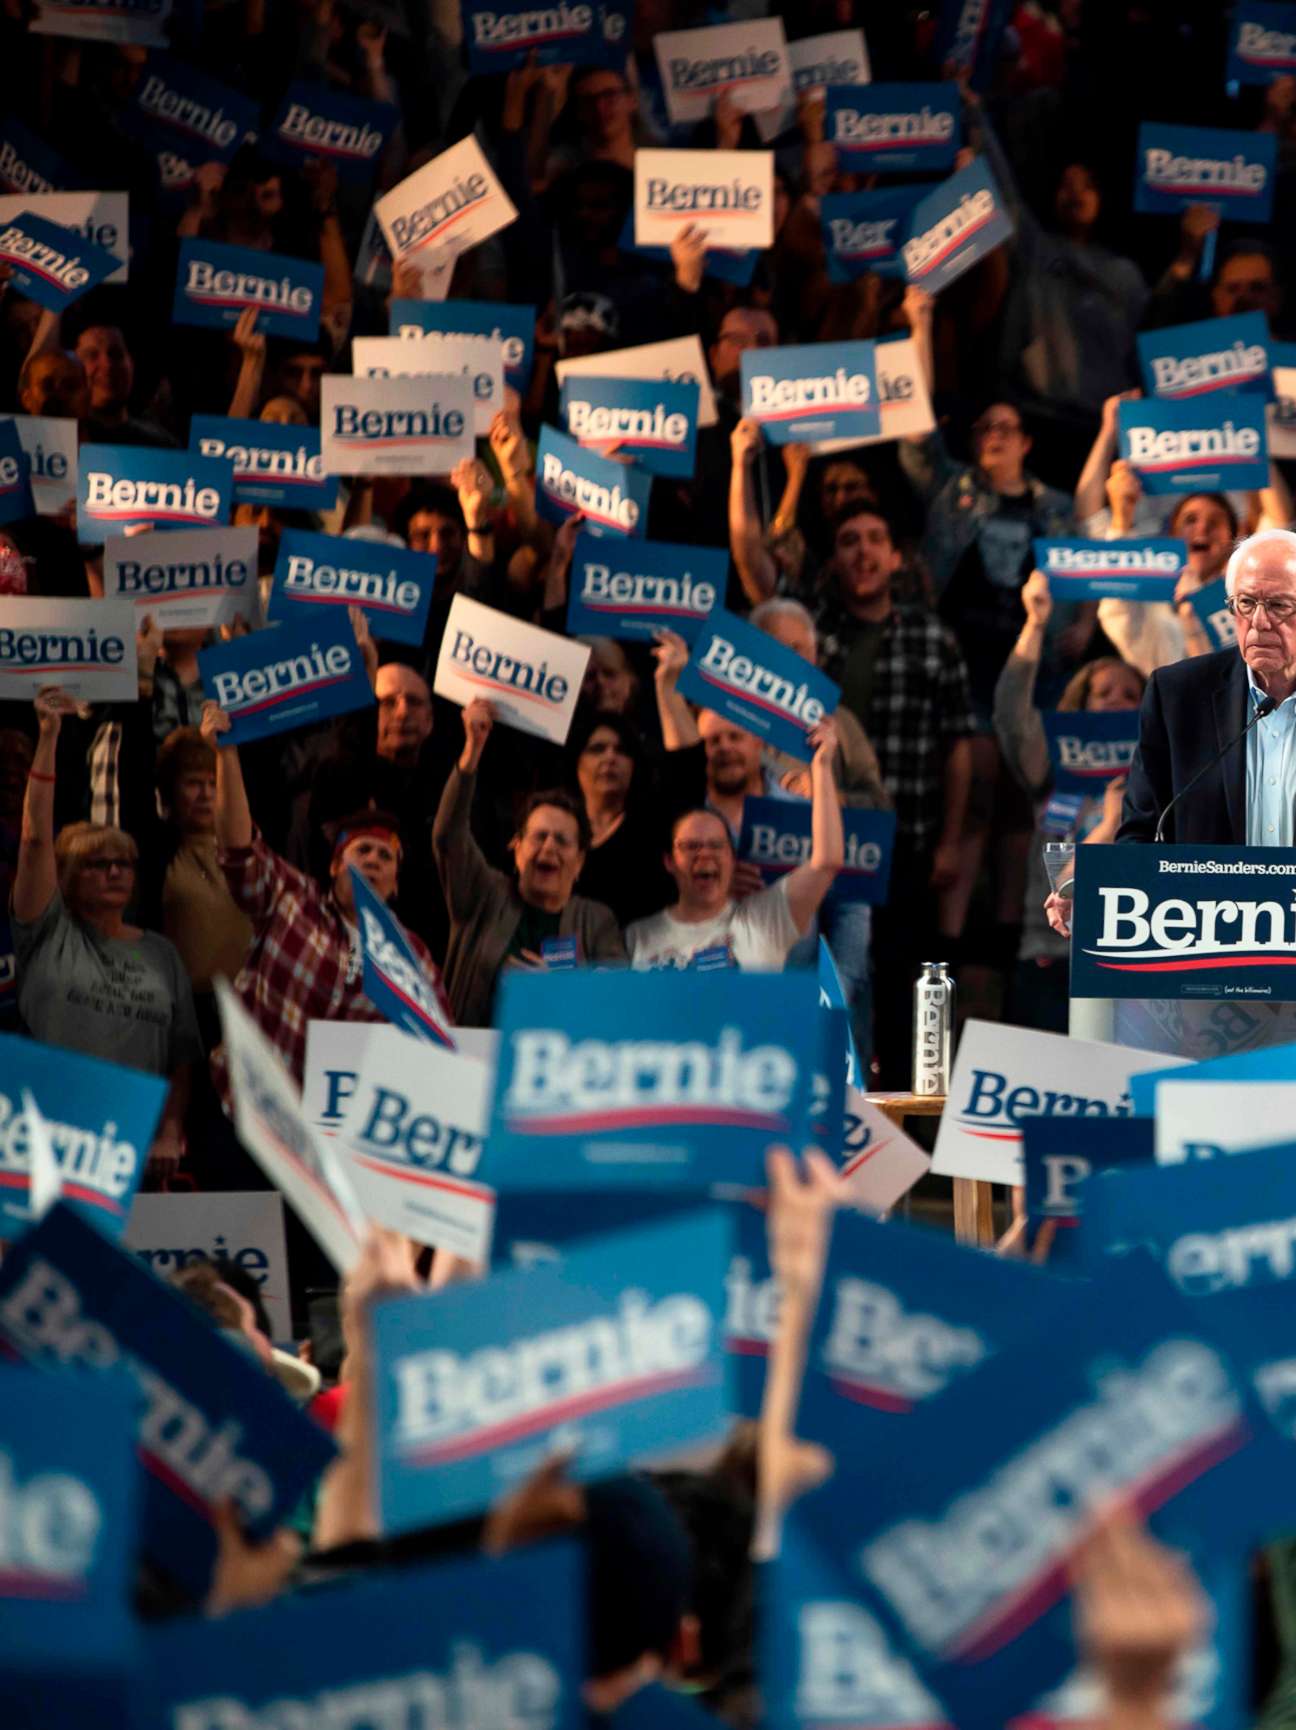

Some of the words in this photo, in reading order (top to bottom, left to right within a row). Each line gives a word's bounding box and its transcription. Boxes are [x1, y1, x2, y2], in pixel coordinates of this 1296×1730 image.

[473, 0, 593, 42] Bernie
[669, 45, 779, 88] Bernie
[141, 76, 237, 147] Bernie
[282, 104, 382, 155] Bernie
[835, 105, 955, 142] Bernie
[645, 174, 762, 212] Bernie
[1145, 148, 1268, 191] Bernie
[390, 171, 490, 249] Bernie
[902, 189, 994, 277] Bernie
[830, 217, 898, 252] Ber
[187, 260, 313, 312] Bernie
[1151, 340, 1268, 390] Bernie
[750, 369, 871, 410] Bernie
[333, 403, 464, 438] Bernie
[567, 400, 688, 444] Bernie
[1127, 421, 1260, 461] Bernie
[86, 472, 220, 517] Bernie
[542, 454, 640, 527] Bernie
[117, 554, 247, 593] Bernie
[1046, 542, 1180, 570] Bernie
[287, 555, 420, 609] Bernie
[582, 562, 716, 610] Bernie
[0, 629, 124, 661] Bernie
[452, 631, 569, 702] Bernie
[213, 642, 351, 705] Bernie
[704, 635, 826, 727] Bernie
[1058, 736, 1139, 771] Bern
[750, 824, 882, 870] Berie
[920, 984, 946, 1095] Bernie
[510, 1025, 799, 1113] Bernie
[364, 1088, 484, 1177] Ber
[393, 1287, 711, 1438] Bernie
[3, 1263, 275, 1512] Benie
